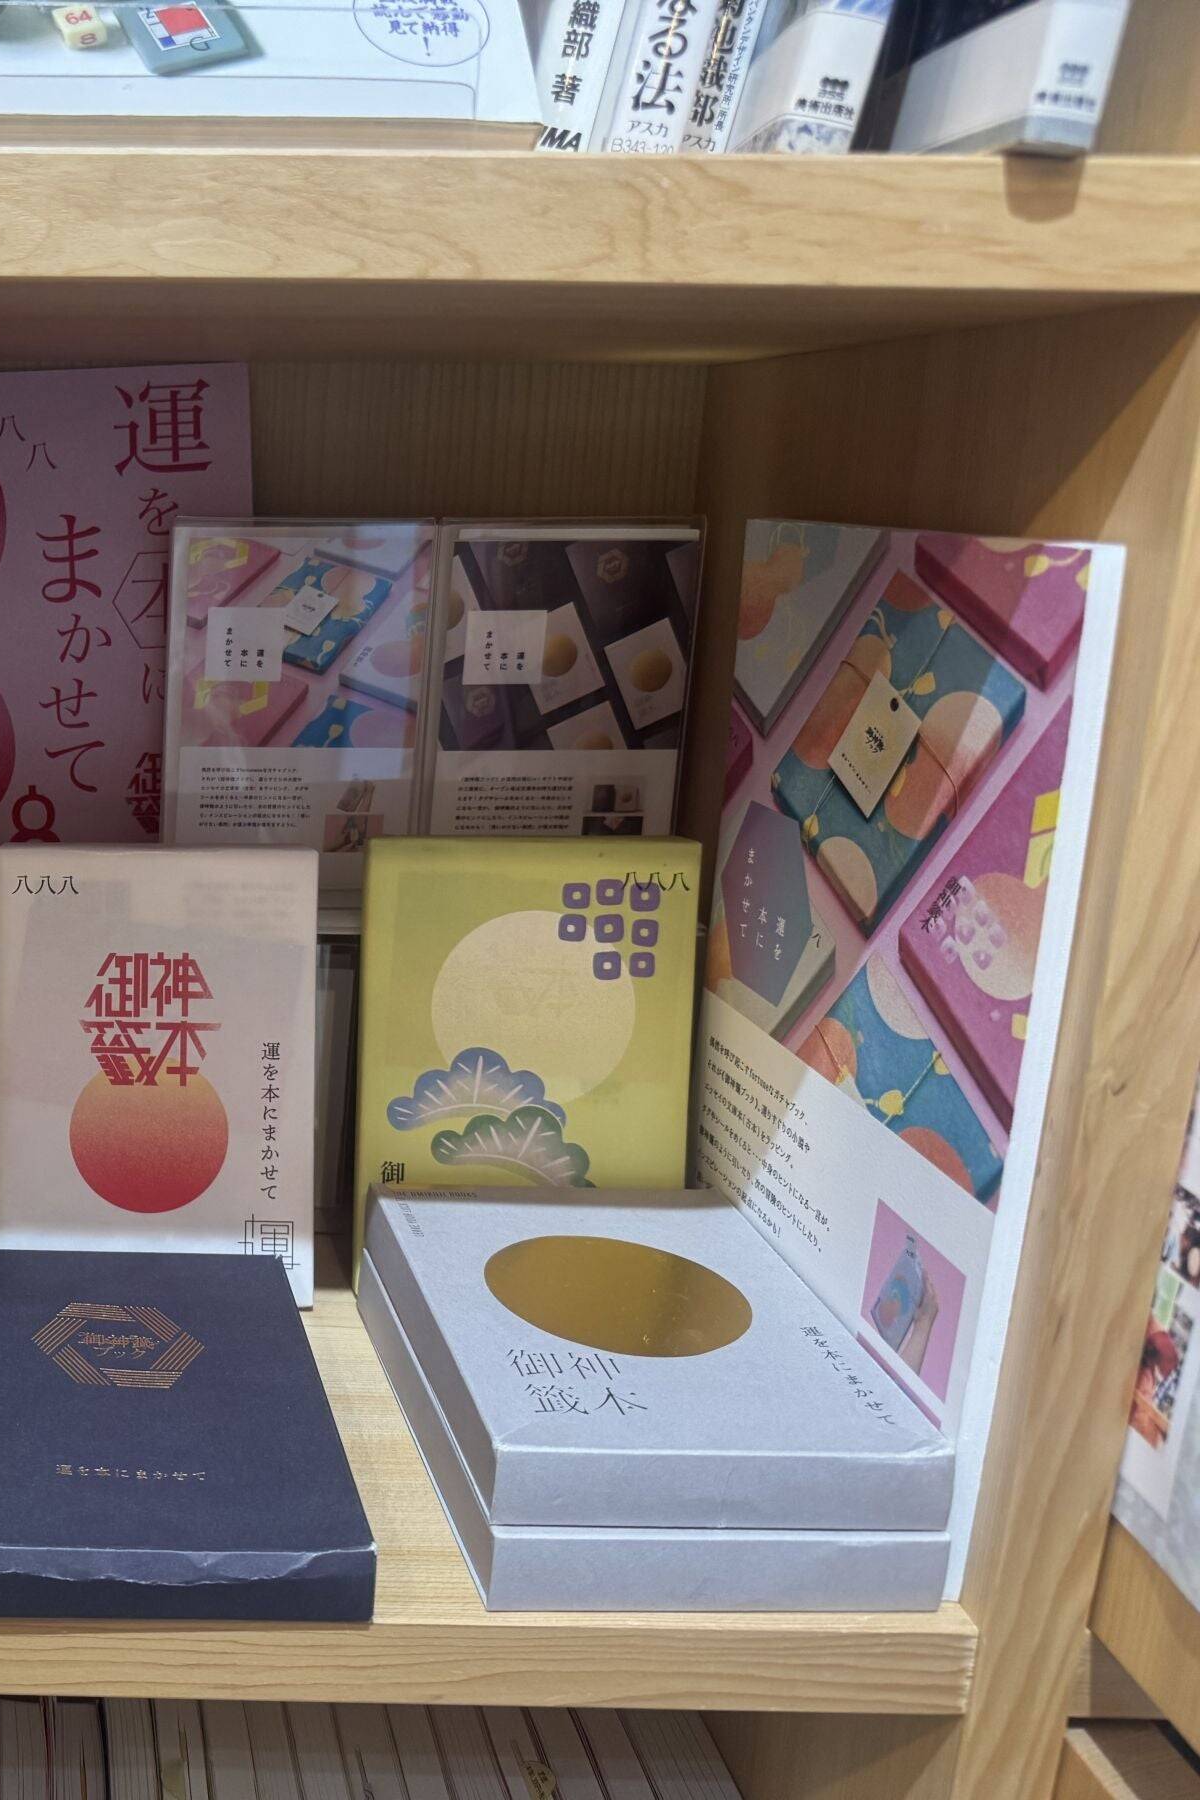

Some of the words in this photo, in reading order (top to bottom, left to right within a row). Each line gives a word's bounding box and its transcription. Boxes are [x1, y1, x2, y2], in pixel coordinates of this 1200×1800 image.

[561, 0, 600, 60] 織部
[551, 73, 583, 106] 著
[537, 125, 582, 152] MA
[625, 120, 669, 138] アスカ
[681, 134, 717, 152] アスカ
[35, 513, 114, 795] まかせて
[11, 874, 80, 896] 八八八
[622, 871, 691, 892] 八八八
[83, 951, 215, 1018] 御神
[78, 1019, 223, 1088] 籤本
[259, 1040, 282, 1201] 運を本にまかせて
[379, 1160, 406, 1186] 御
[505, 1346, 622, 1381] 御神
[799, 1324, 897, 1427] 運を本にまかせて
